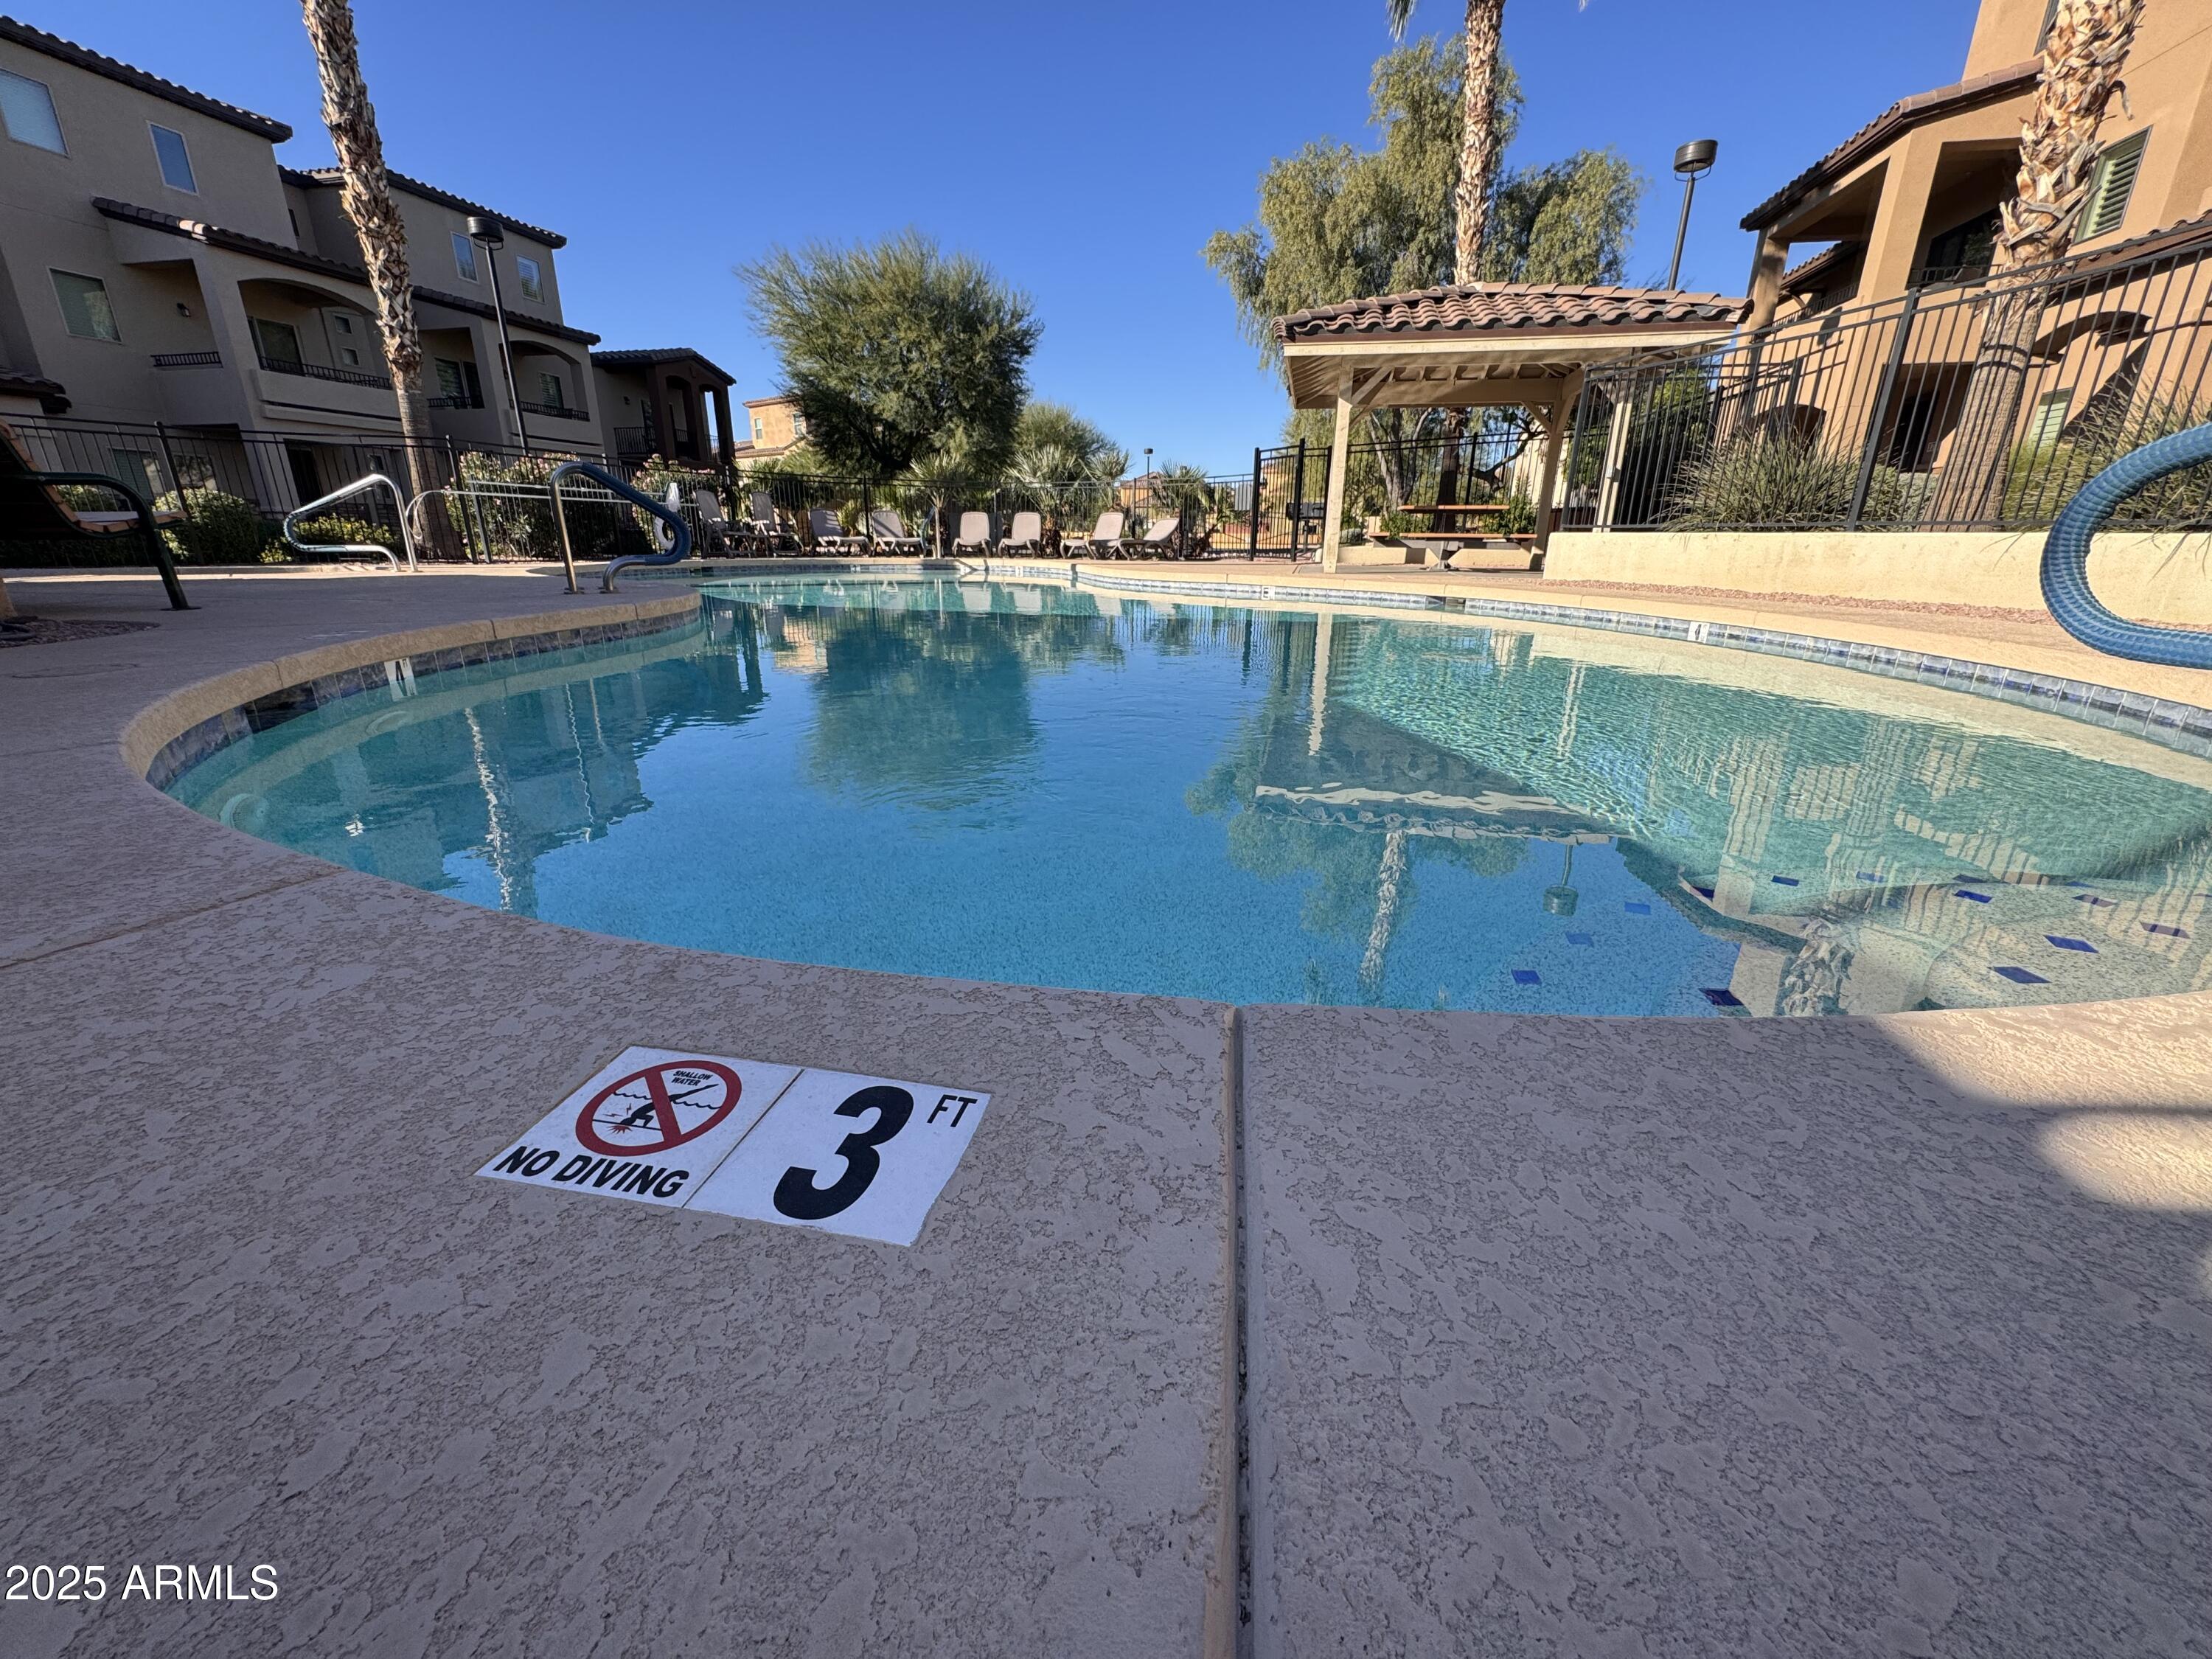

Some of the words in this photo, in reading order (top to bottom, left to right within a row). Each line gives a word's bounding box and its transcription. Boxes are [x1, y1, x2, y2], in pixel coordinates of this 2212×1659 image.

[671, 1077, 701, 1086] WATER
[672, 1070, 713, 1080] SHALLOW
[773, 1085, 914, 1220] 3
[926, 1094, 978, 1127] FT
[493, 1146, 560, 1177] NO
[551, 1155, 689, 1197] DIVING
